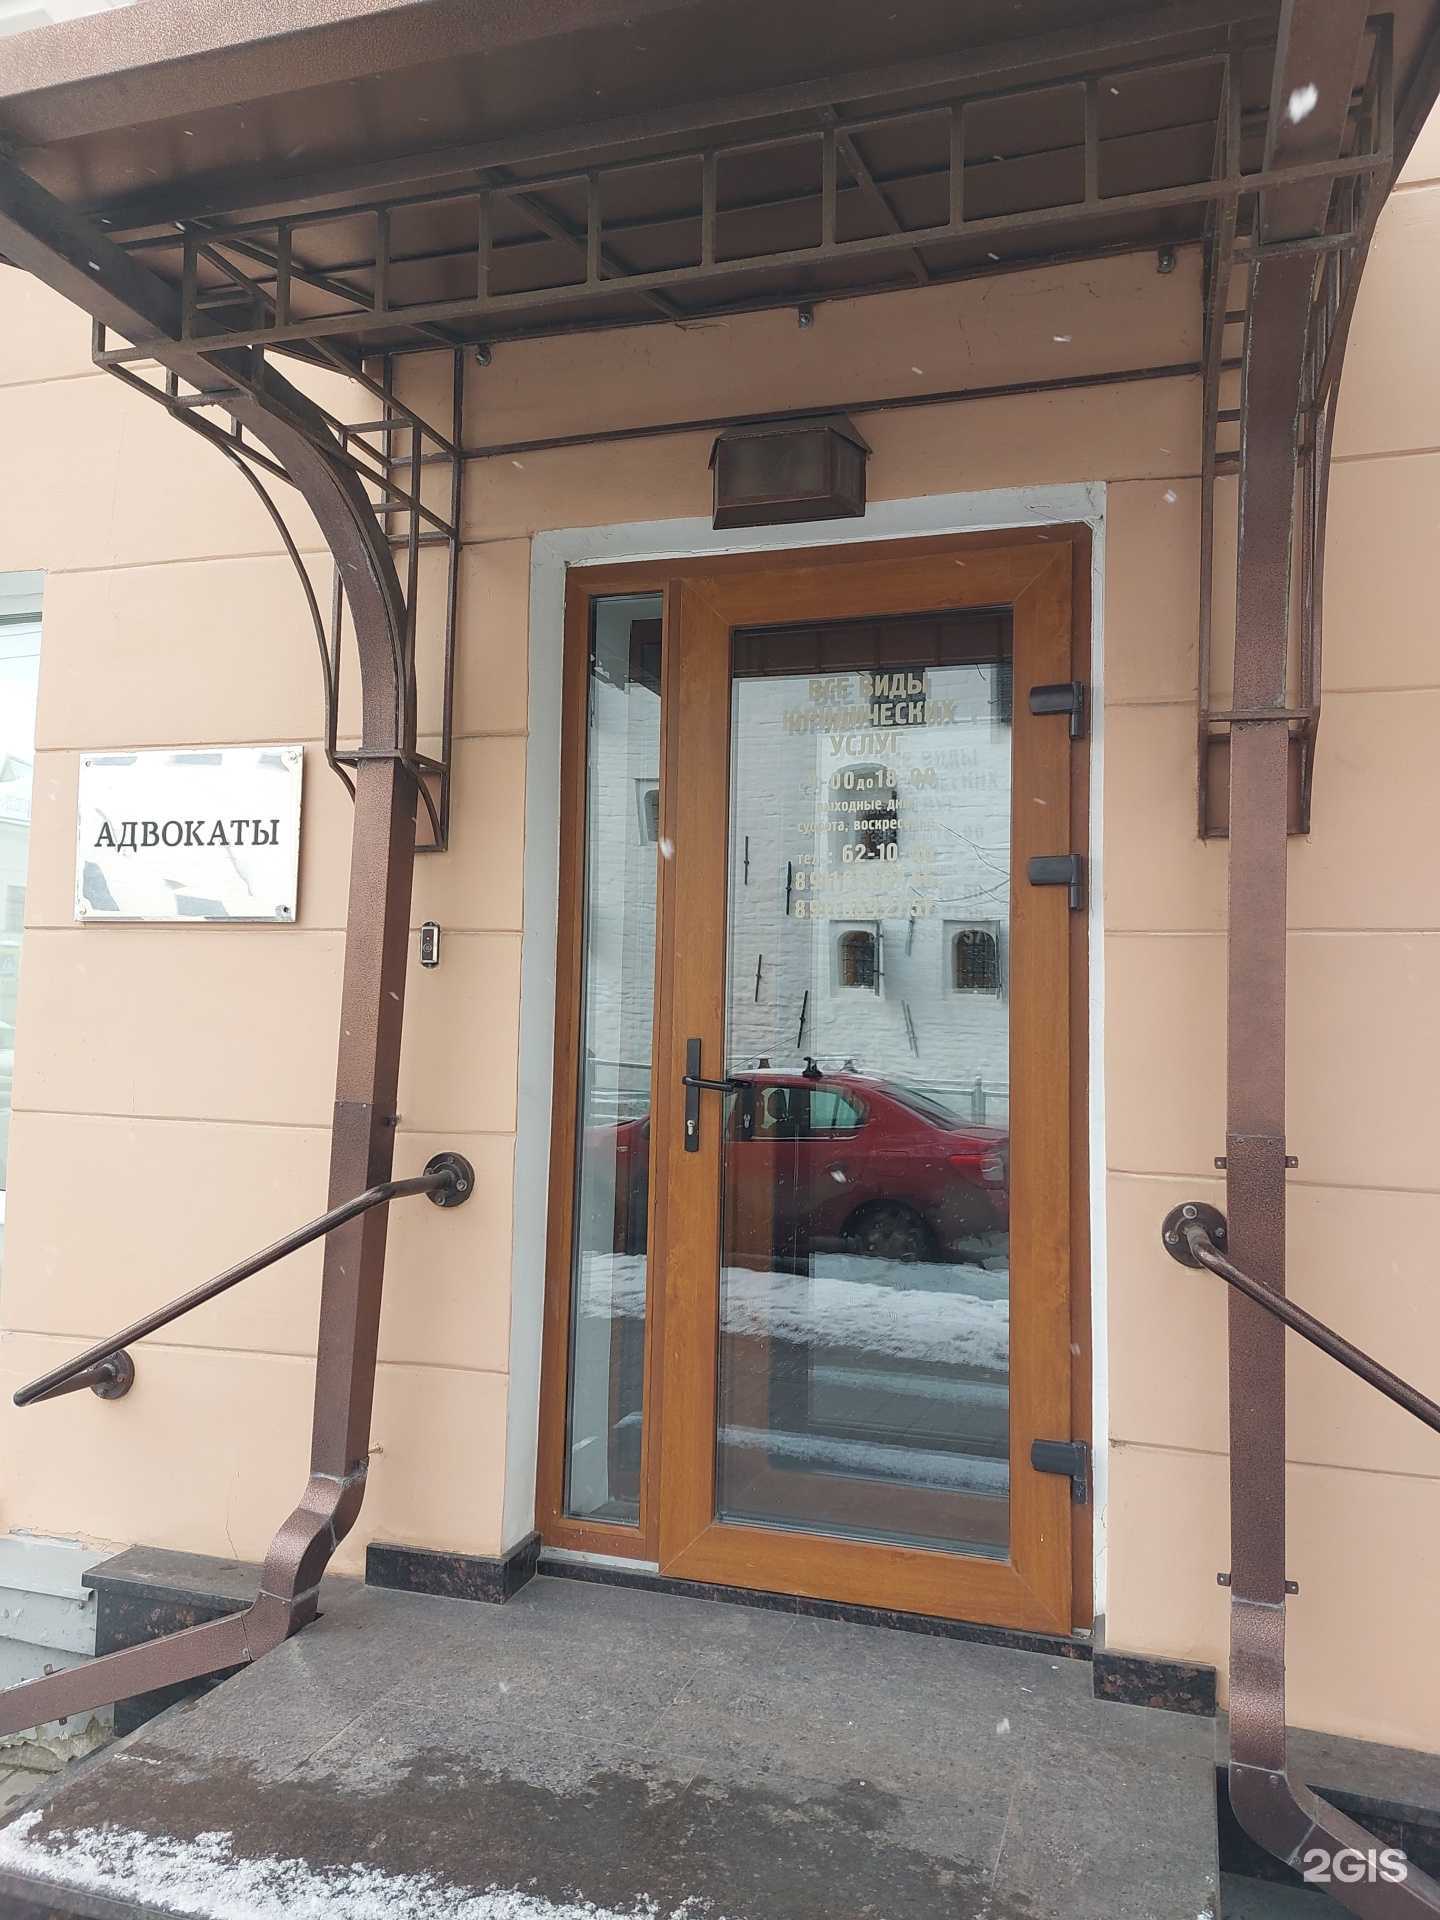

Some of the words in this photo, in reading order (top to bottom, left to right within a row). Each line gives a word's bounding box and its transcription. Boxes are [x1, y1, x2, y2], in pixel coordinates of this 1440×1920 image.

[860, 672, 930, 699] ВИДЫ
[829, 733, 901, 757] УСЛУГ
[94, 819, 280, 853] АДВОКАТЫ
